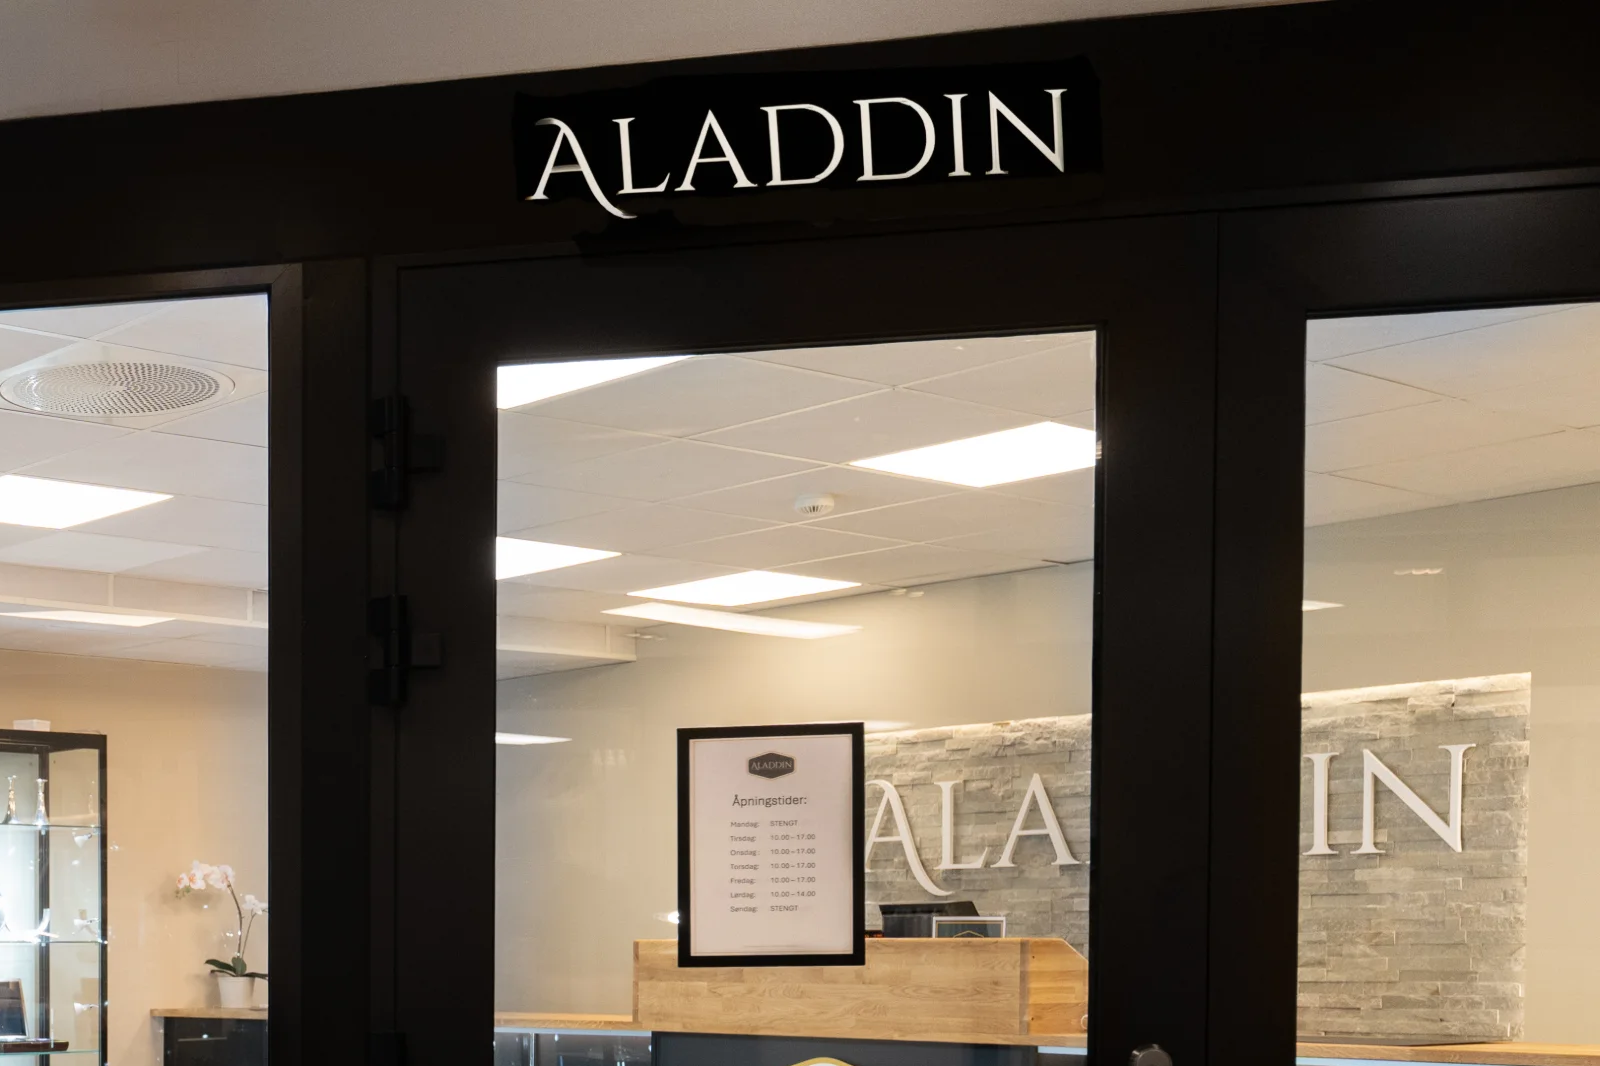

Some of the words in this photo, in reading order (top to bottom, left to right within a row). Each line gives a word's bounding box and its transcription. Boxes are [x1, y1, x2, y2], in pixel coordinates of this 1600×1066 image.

[525, 88, 1068, 219] ALADDIN
[750, 760, 792, 771] ALADDIN
[732, 794, 807, 808] Åpningstider:
